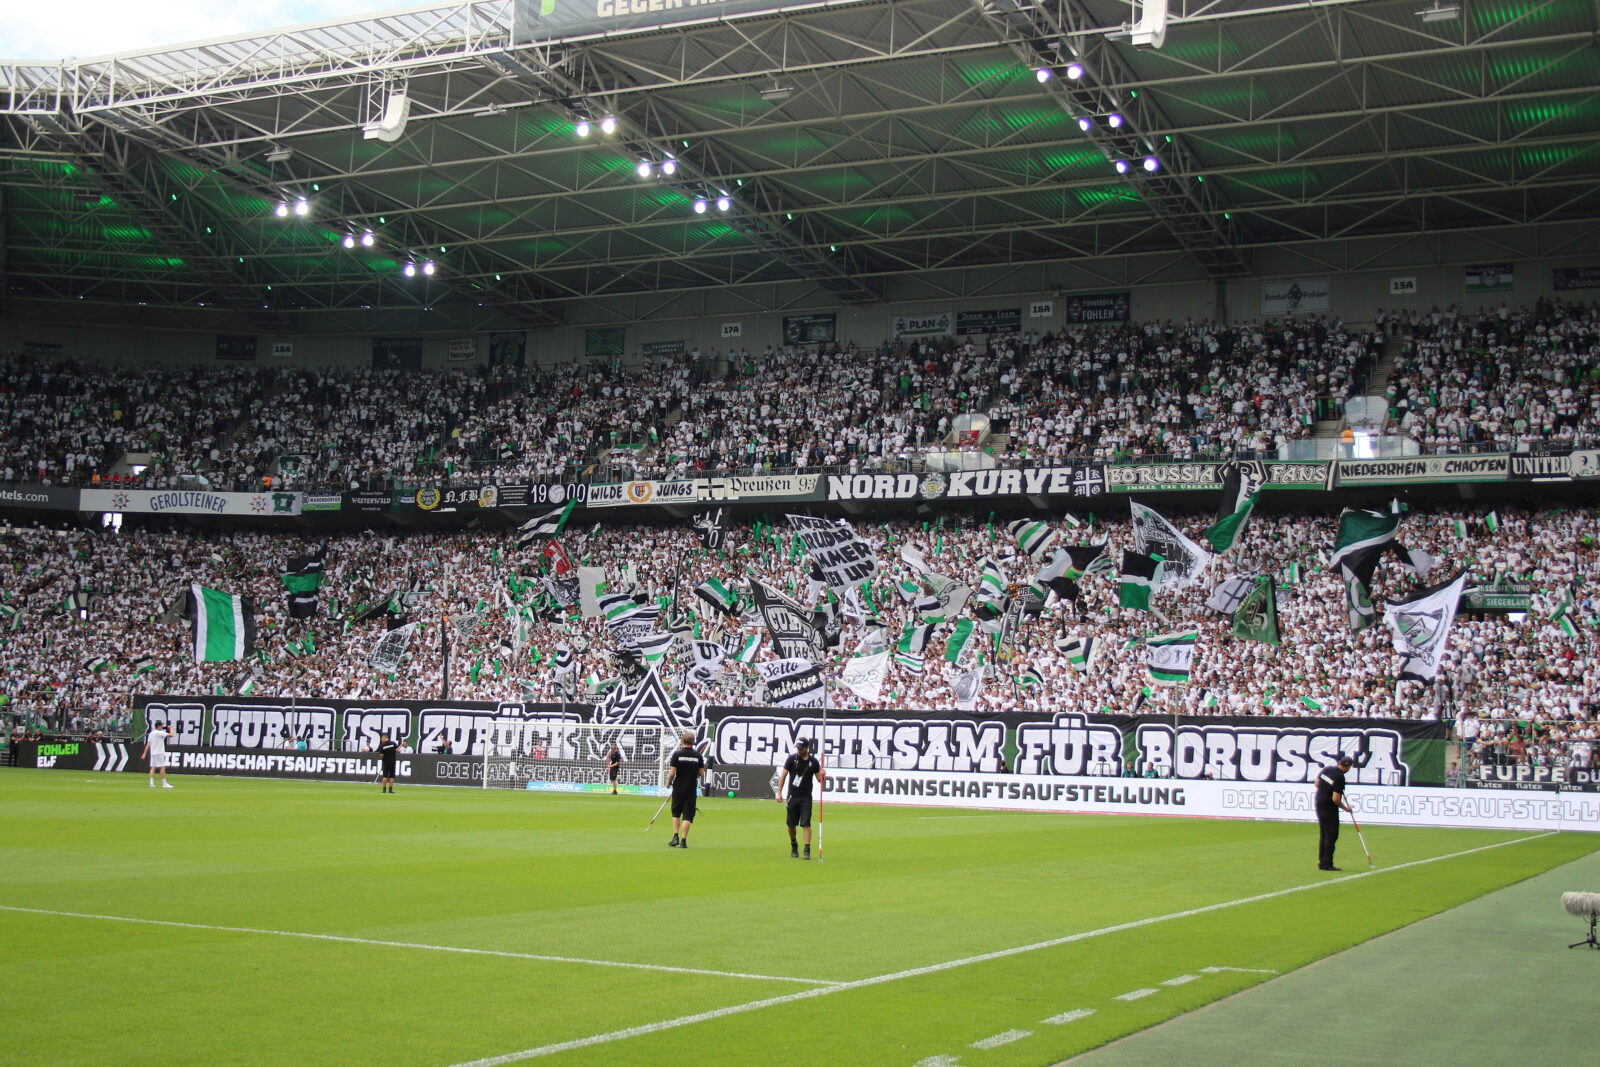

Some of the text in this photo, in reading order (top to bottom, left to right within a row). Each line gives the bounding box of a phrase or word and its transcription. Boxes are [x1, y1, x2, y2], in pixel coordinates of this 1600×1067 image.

[1393, 281, 1413, 290] 15A
[1032, 305, 1050, 314] 16A
[1082, 309, 1114, 321] FOHLEN
[723, 326, 739, 335] 17A
[909, 320, 936, 330] PLAN
[1109, 465, 1328, 484] BORUSSIA FANS
[1340, 458, 1507, 477] NIEDERRHEIN CHAOTEN
[1511, 456, 1571, 475] UNITED
[531, 484, 547, 503] 19
[566, 483, 586, 502] 00
[591, 483, 692, 500] WILDE JUNGS
[730, 477, 790, 495] Preußen
[828, 468, 1072, 500] NORD KURVE
[150, 491, 226, 513] GEROLSTEINER
[352, 497, 391, 505] WESTERWALD
[1486, 598, 1530, 606] SIEGERLAND
[770, 675, 818, 698] ultura
[147, 706, 578, 759] DIE KURVE IST ZURÜCK
[37, 743, 79, 756] FOHLEN
[719, 717, 1400, 785] GEMEINSAM FÜR BORUSSIA
[37, 756, 57, 767] ELF
[165, 752, 412, 776] IE MANNSCHAFTSAUFSTELLG
[437, 761, 469, 779] DIE
[1480, 765, 1566, 782] FUPPE
[822, 776, 1186, 806] DIE MANNSCHAFTSAUFSTELLUNG
[1477, 781, 1502, 789] flatex
[1516, 782, 1542, 790] flatex
[1222, 789, 1600, 822] DIE MASCHAFTSAUFSTELL
